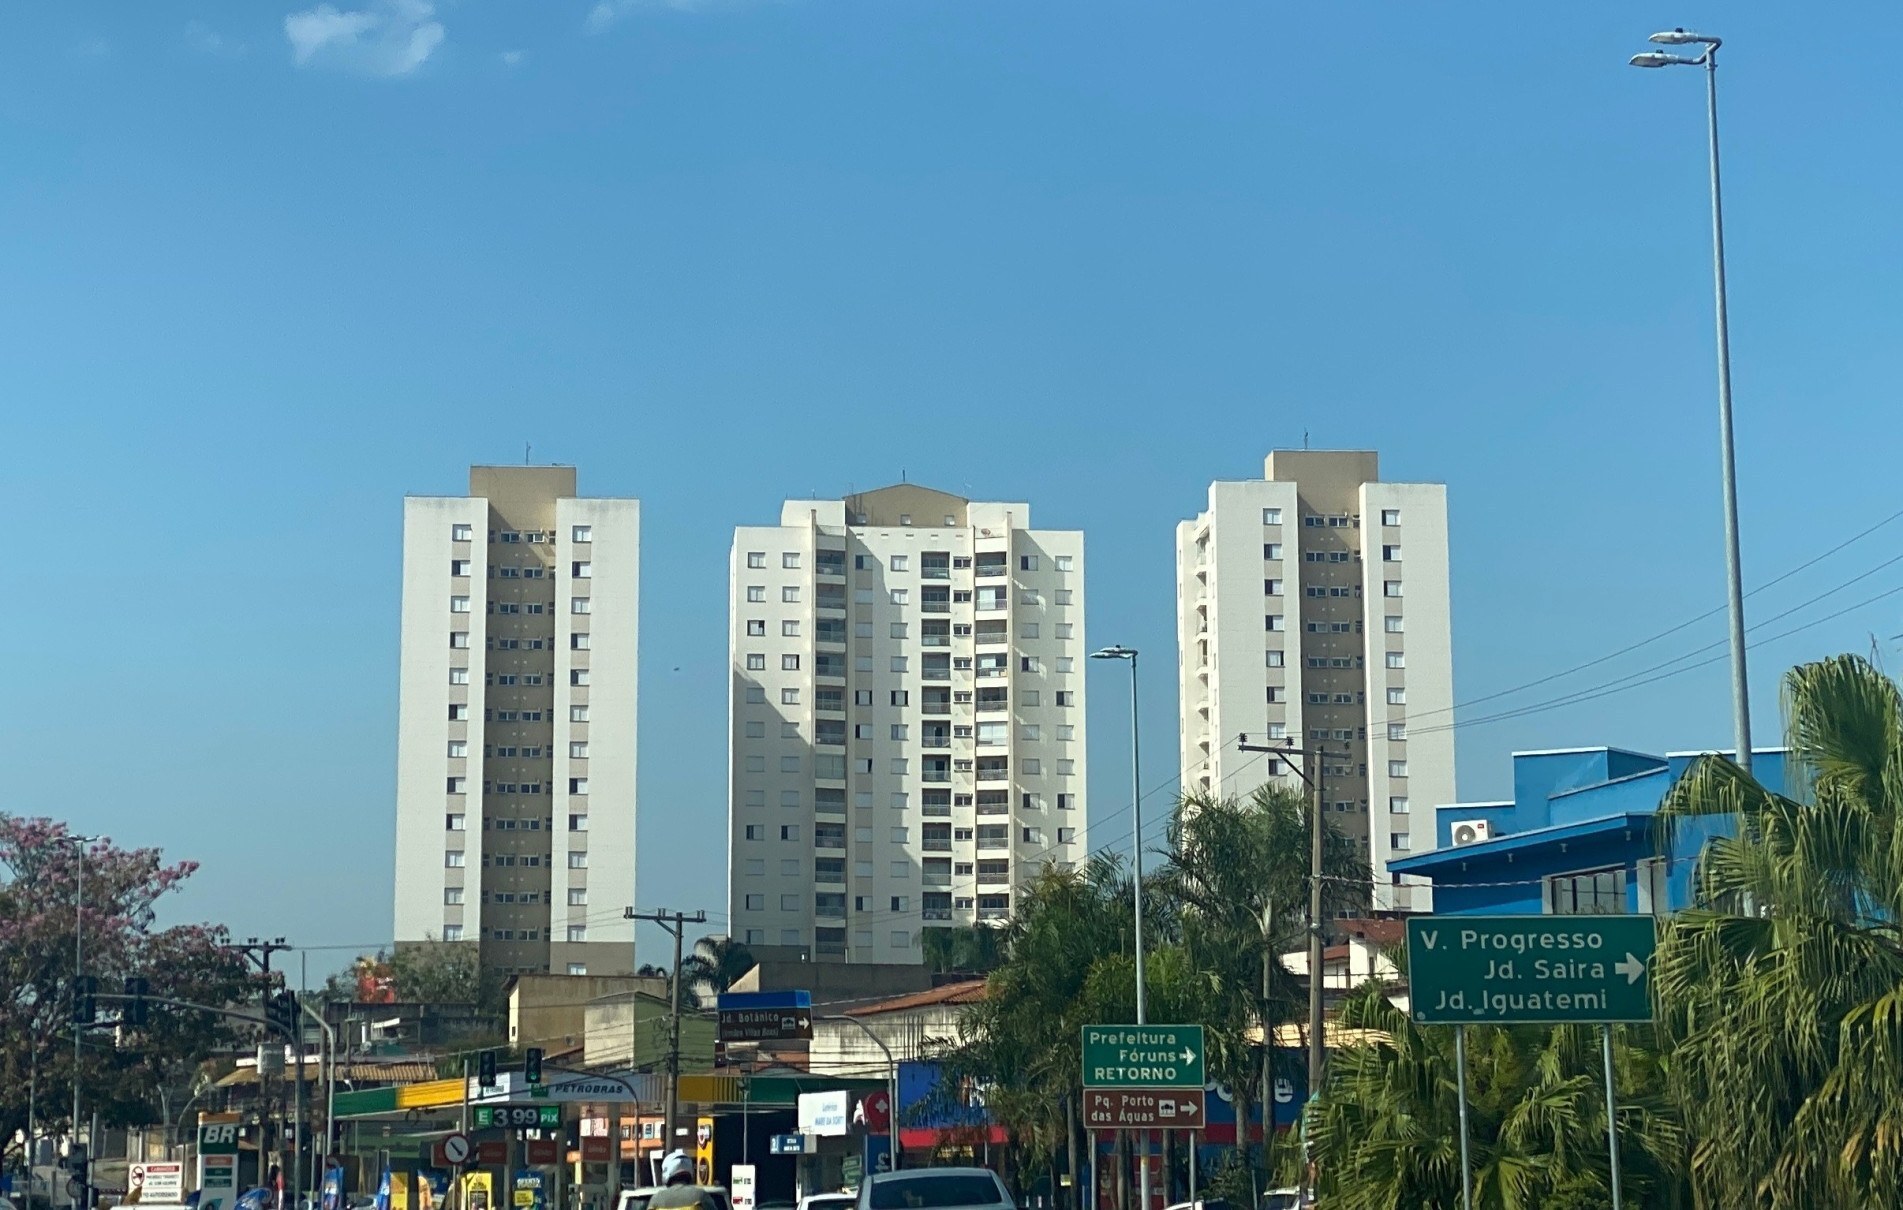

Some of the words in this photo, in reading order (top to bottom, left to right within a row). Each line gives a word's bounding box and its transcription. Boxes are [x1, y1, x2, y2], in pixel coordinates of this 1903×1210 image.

[1421, 930, 1447, 950] V.
[1461, 930, 1603, 954] Progresso
[1484, 959, 1522, 980] Jd.
[1534, 958, 1605, 980] Saira
[1435, 990, 1473, 1010] Jd.
[1483, 988, 1607, 1015] Iguatemi
[1090, 1031, 1176, 1045] Prefeitura
[1119, 1048, 1176, 1062] Fóruns
[1095, 1067, 1177, 1080] RETORNO
[555, 1084, 623, 1094] PETROBRAS
[1095, 1095, 1113, 1109] Pq.
[1122, 1095, 1154, 1106] Porto
[478, 1110, 489, 1125] E
[1091, 1111, 1112, 1122] das
[1119, 1108, 1154, 1124] Águas
[203, 1126, 235, 1144] BR
